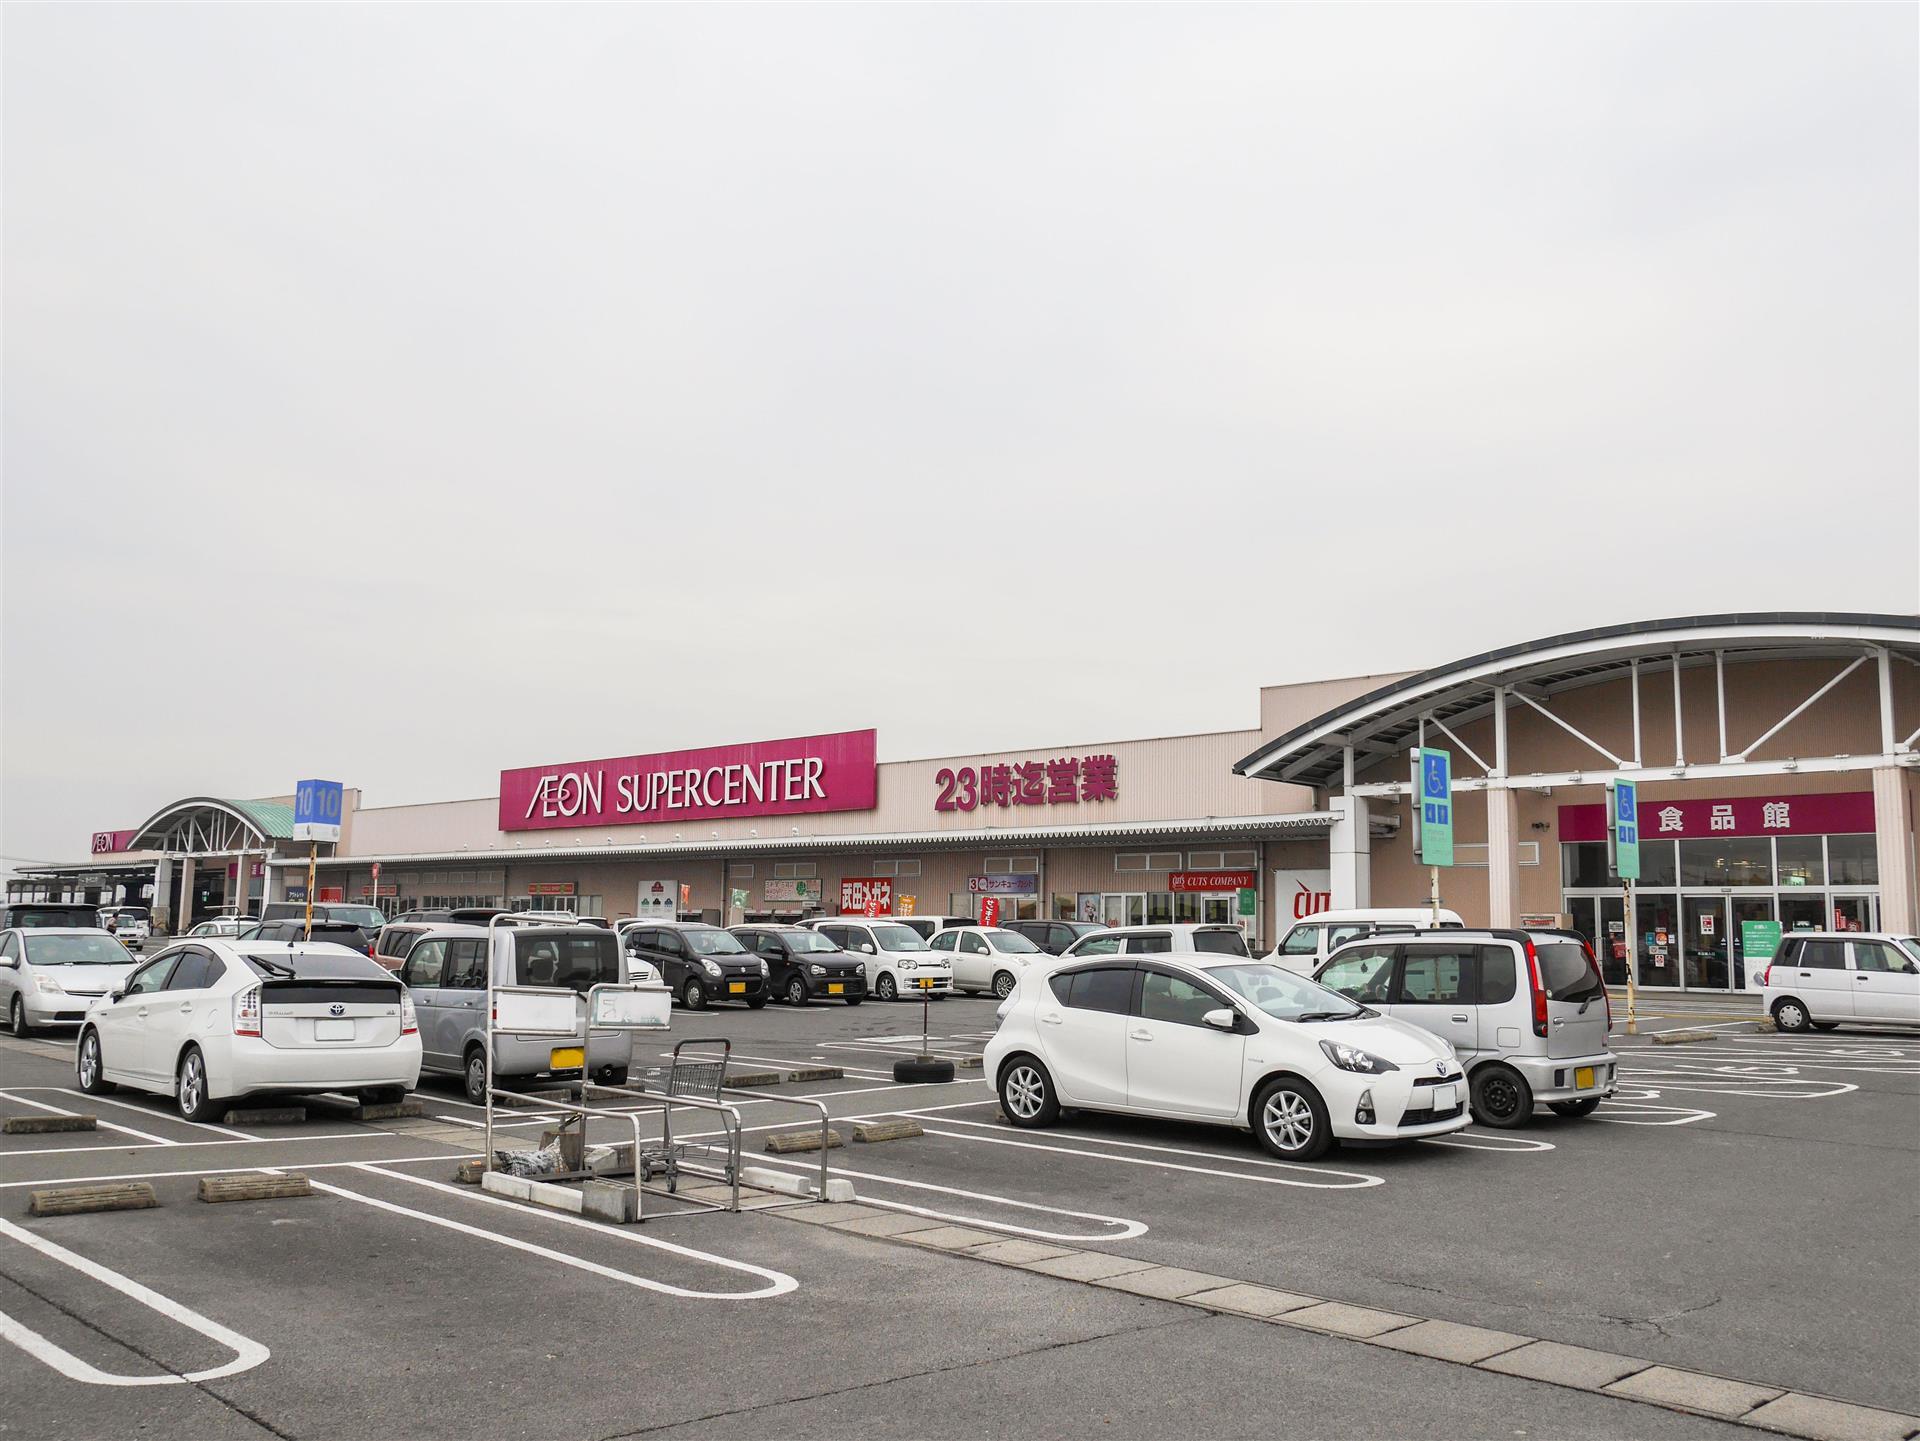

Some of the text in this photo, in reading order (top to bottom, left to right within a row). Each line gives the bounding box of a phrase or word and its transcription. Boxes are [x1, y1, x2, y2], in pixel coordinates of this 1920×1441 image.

[616, 757, 826, 813] SUPERCENTER
[935, 755, 1118, 812] 23時迄営業
[298, 787, 312, 816] 10
[317, 788, 339, 818] 10
[1658, 802, 1790, 832] 食品館
[1187, 876, 1249, 887] CUTS COMPANY
